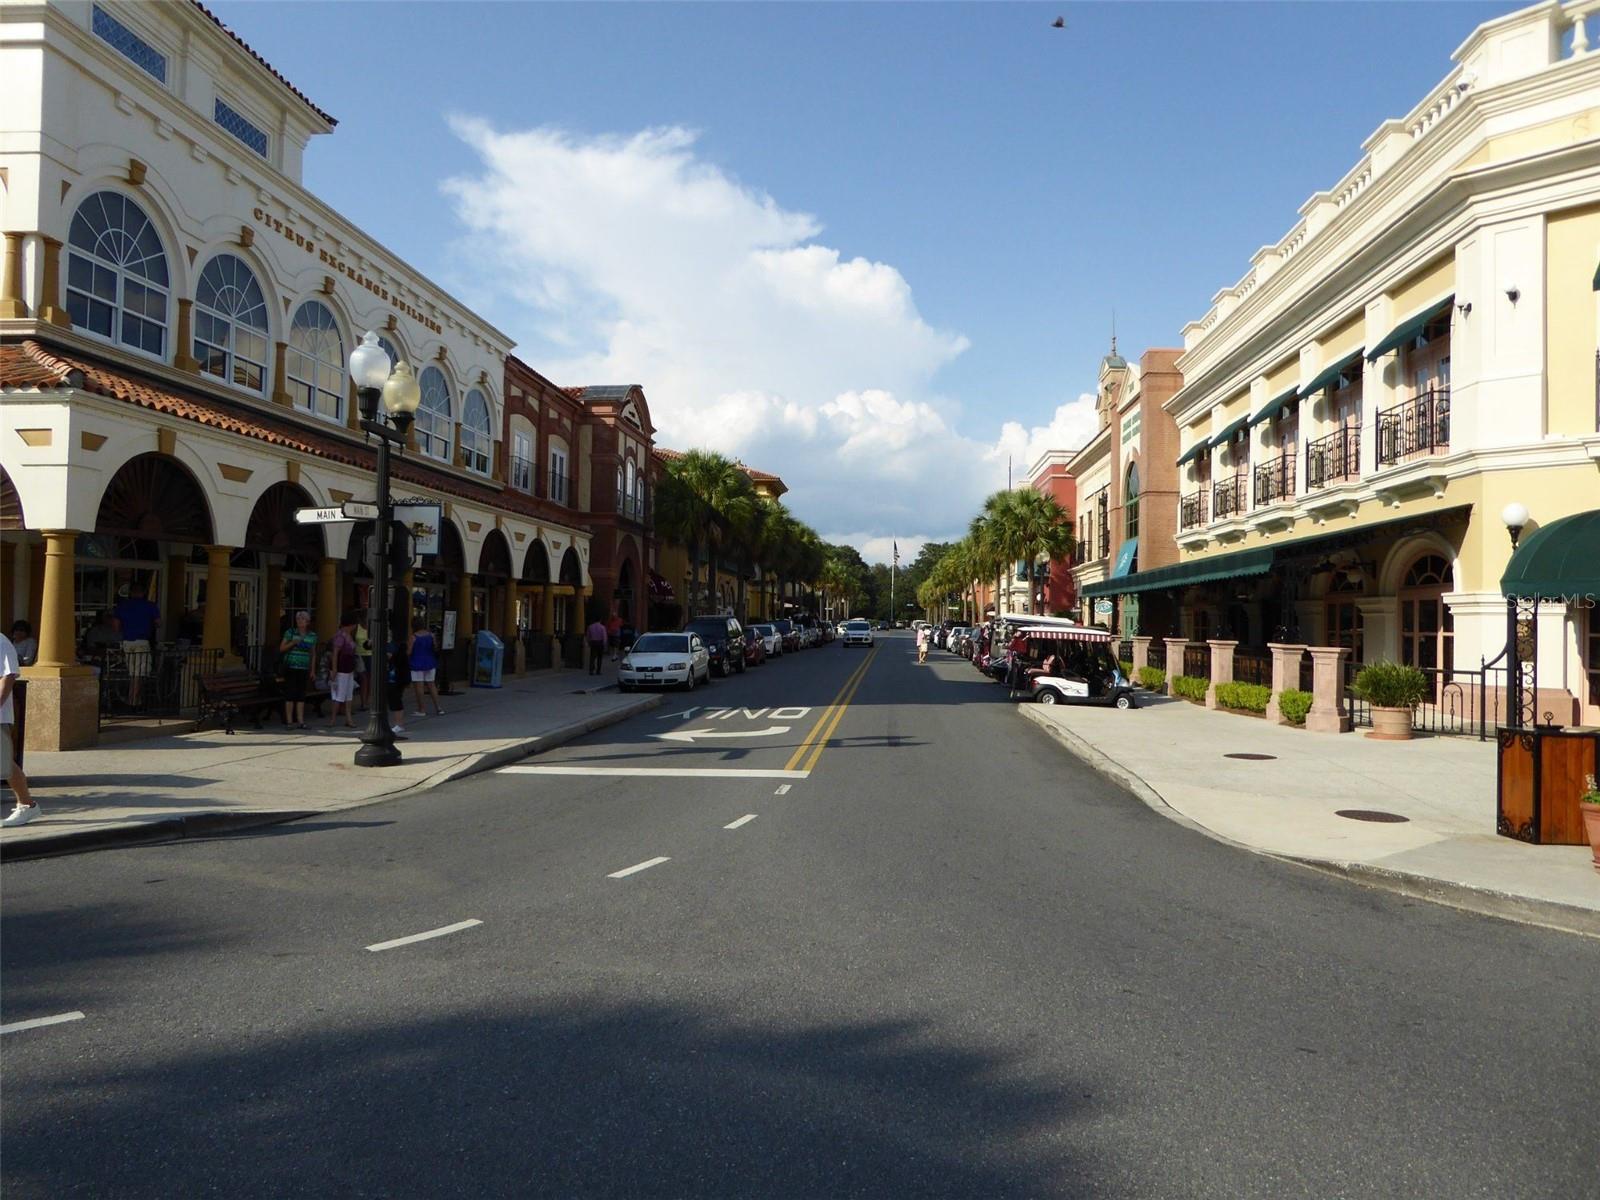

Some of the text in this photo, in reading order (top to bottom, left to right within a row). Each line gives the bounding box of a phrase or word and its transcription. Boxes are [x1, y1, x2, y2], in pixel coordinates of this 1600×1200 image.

[253, 207, 442, 335] CITRUS EXCHANGE BUILDING
[316, 509, 336, 520] MAIN
[656, 706, 812, 720] ONLY
